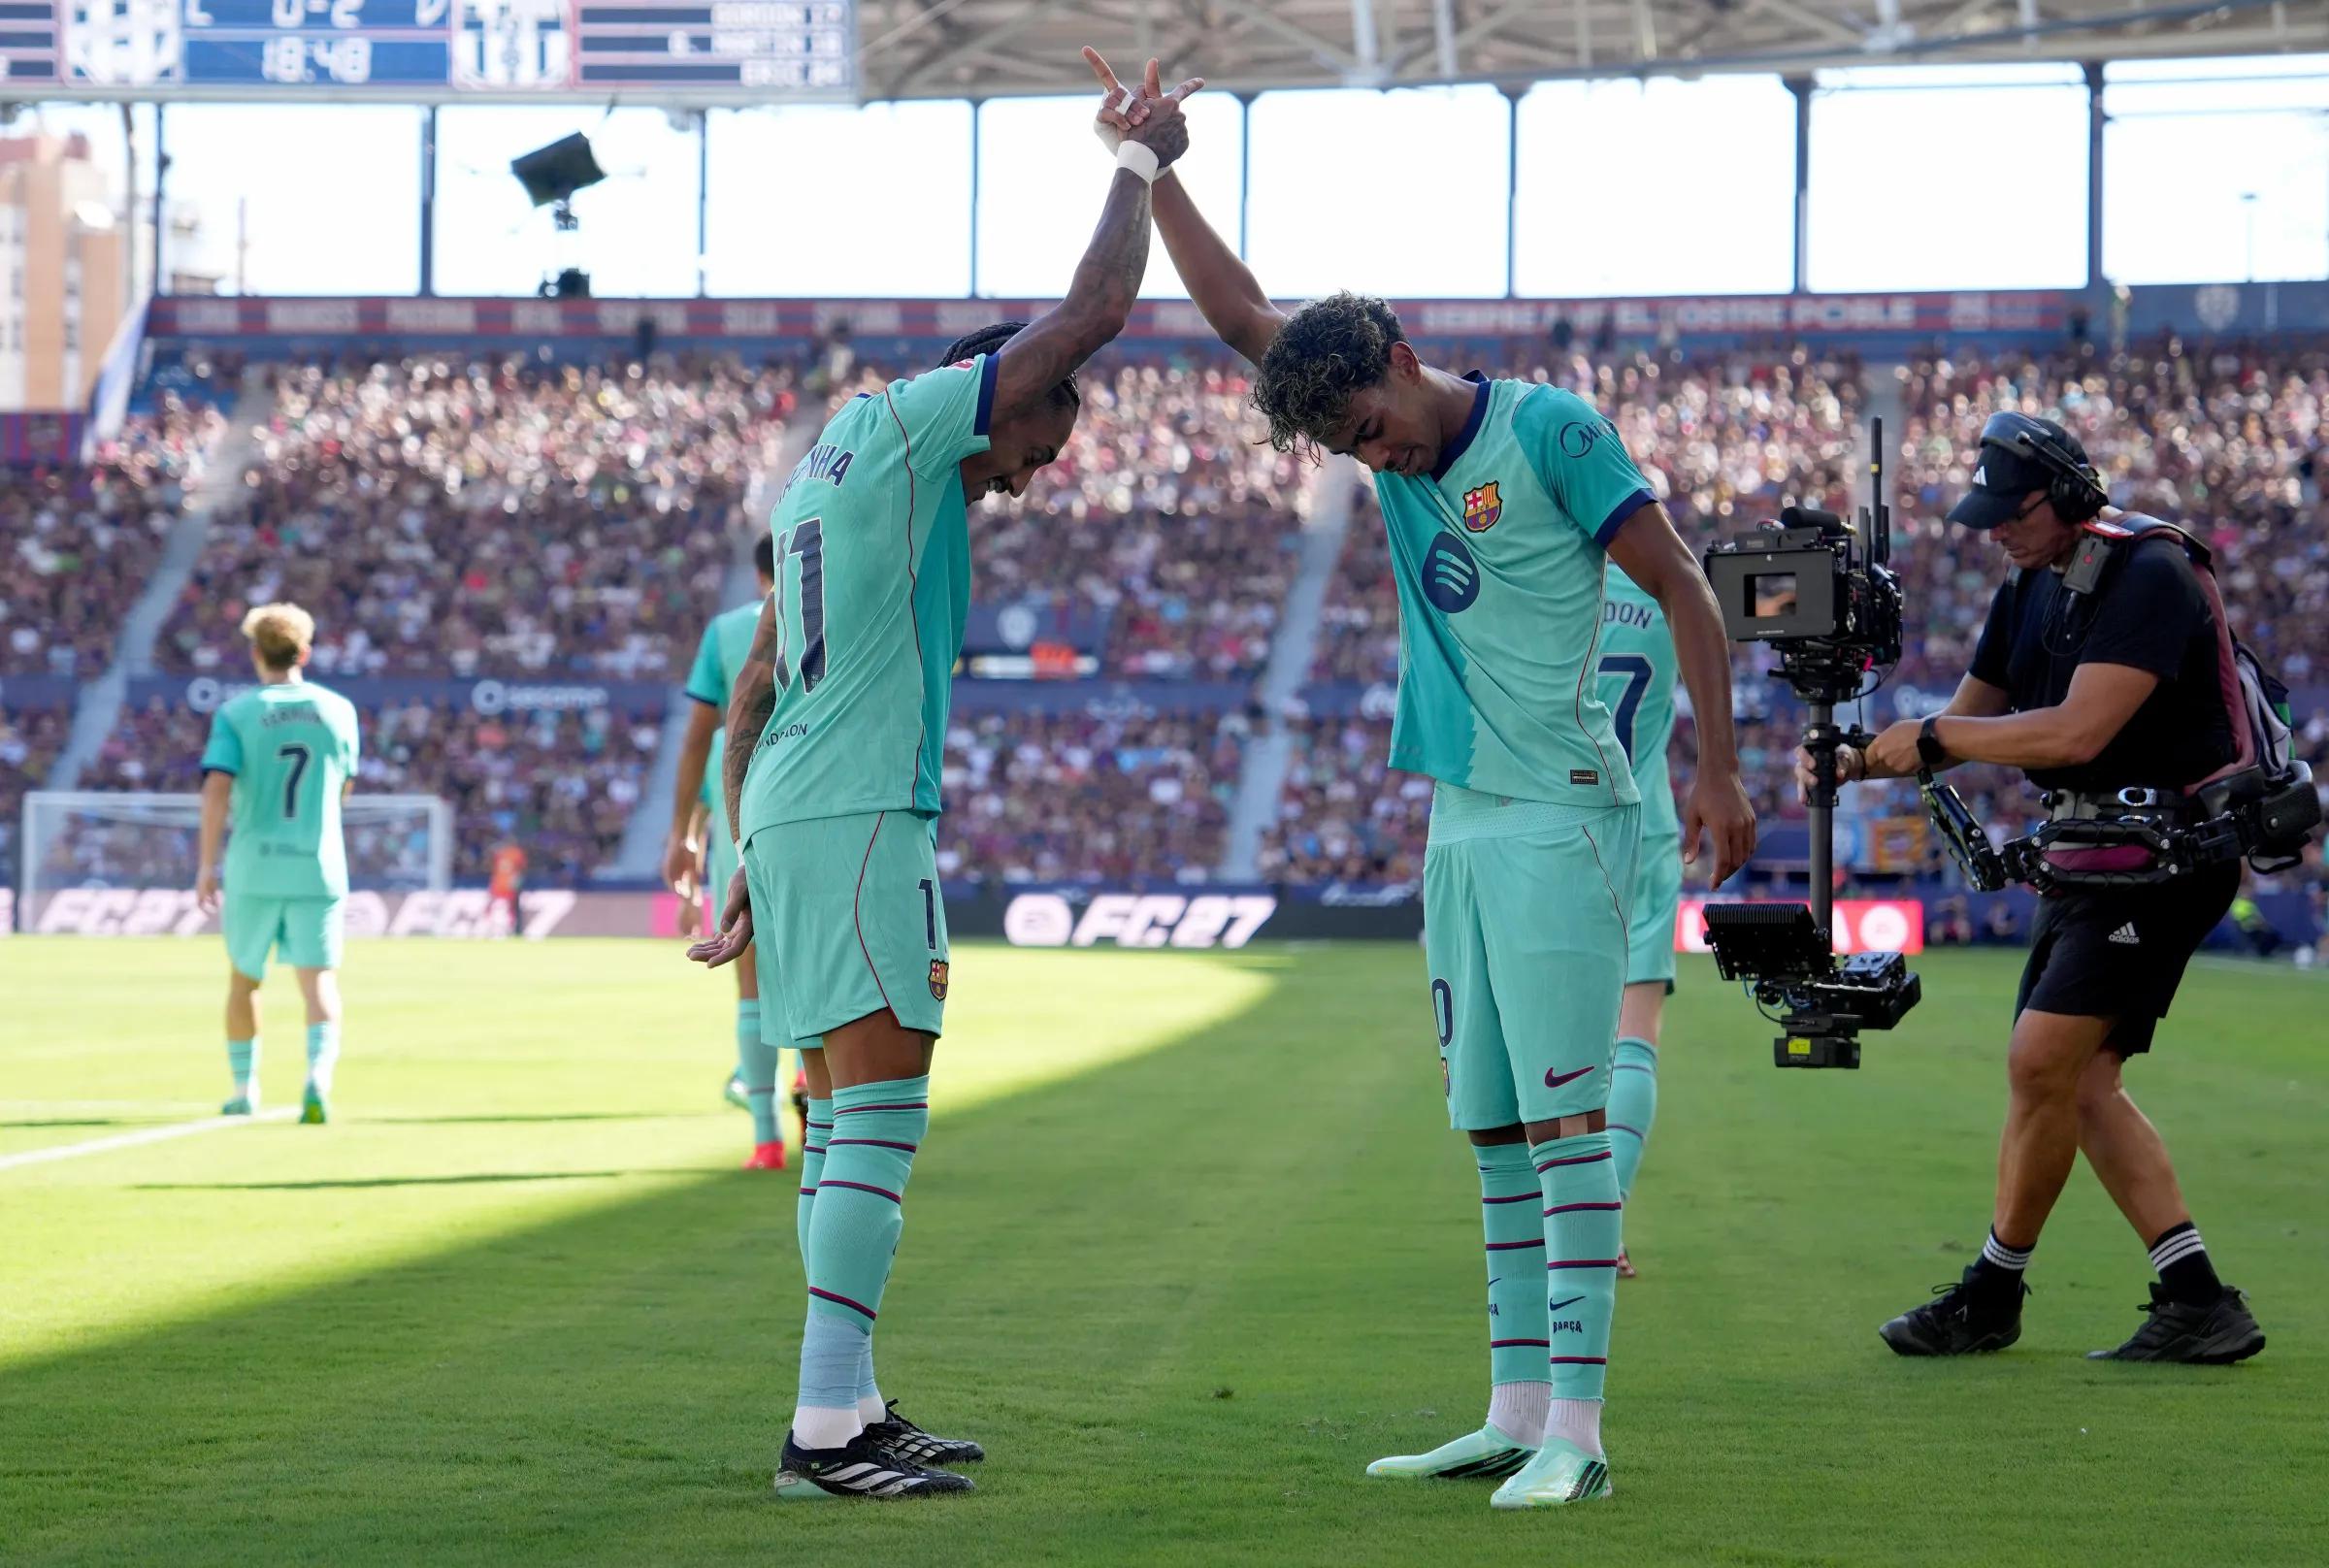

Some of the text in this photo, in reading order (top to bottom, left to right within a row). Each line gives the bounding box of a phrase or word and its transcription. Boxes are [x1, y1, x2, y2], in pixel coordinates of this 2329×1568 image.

[1604, 601, 1653, 630] DON
[278, 742, 311, 819] 7
[2108, 932, 2141, 945] adidas
[1553, 1320, 1583, 1335] BARÇA
